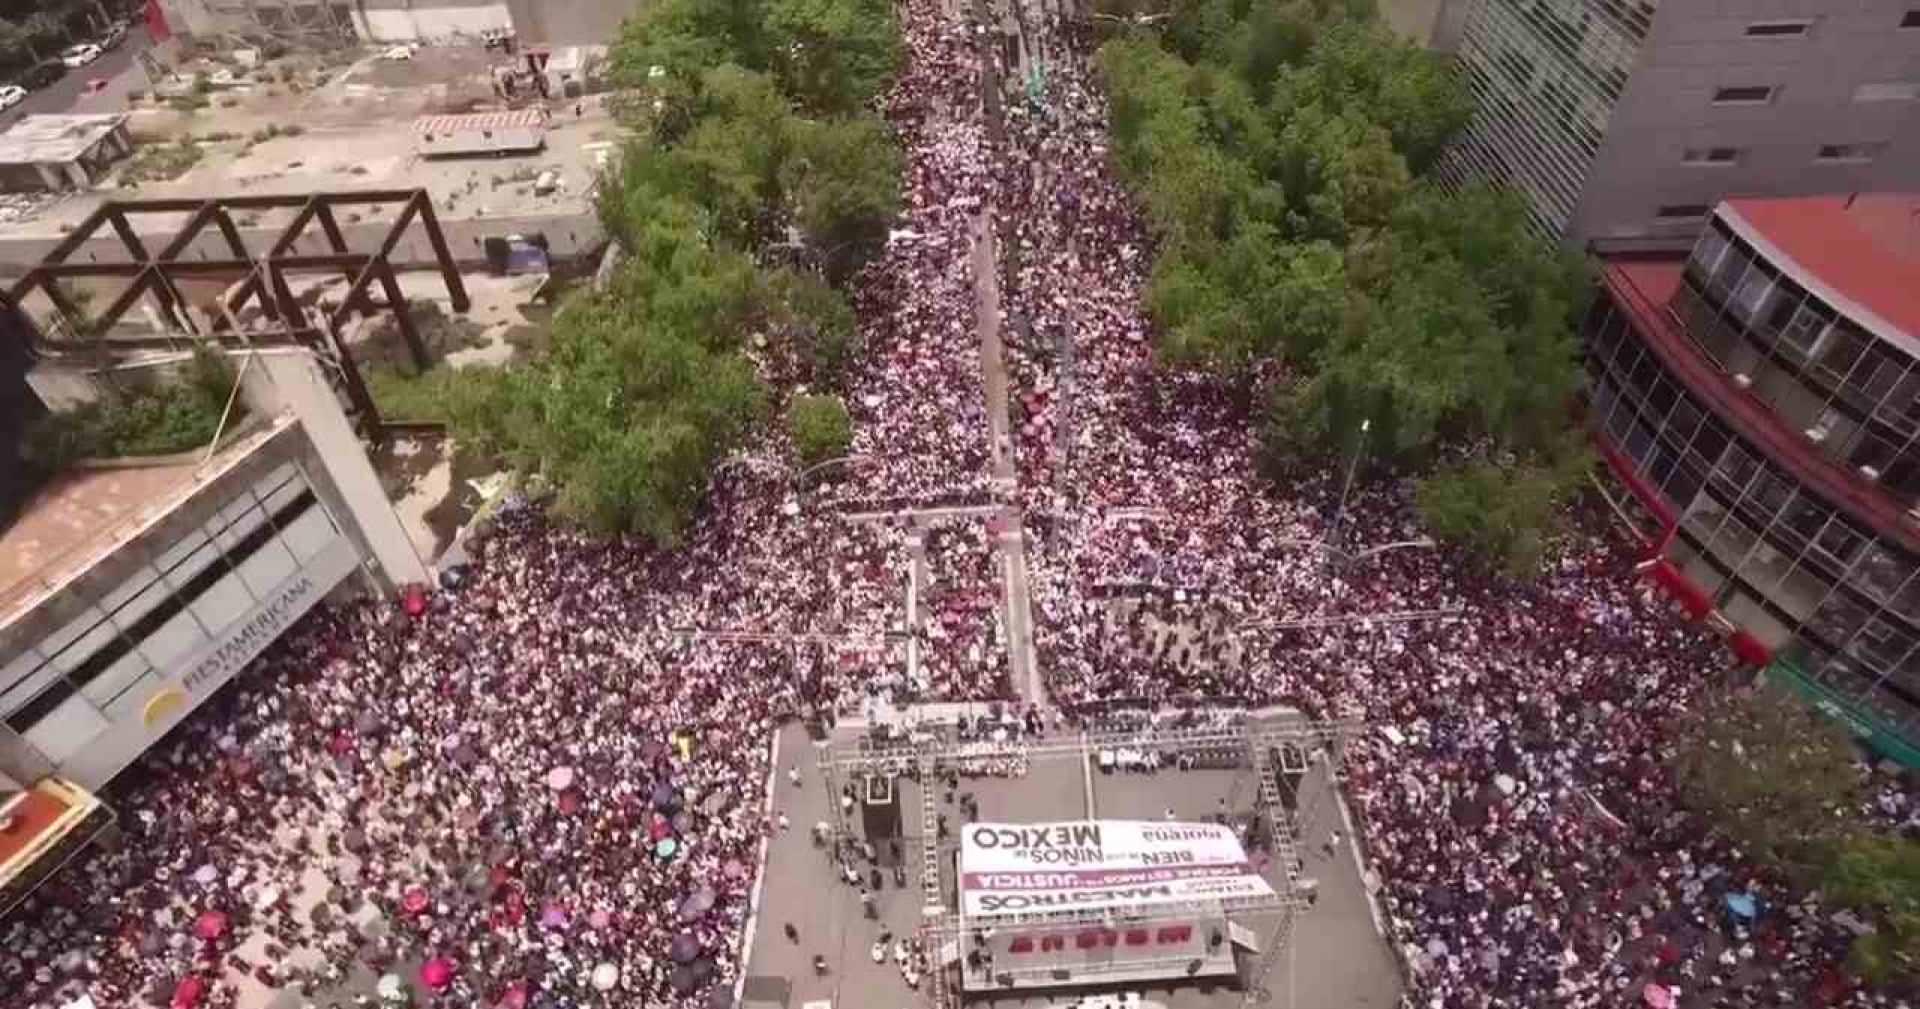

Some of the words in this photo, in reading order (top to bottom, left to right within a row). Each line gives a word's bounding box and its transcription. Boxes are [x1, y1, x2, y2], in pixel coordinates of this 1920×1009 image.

[1030, 848, 1104, 868] NIÑOS
[1140, 850, 1194, 866] BIEN
[977, 874, 1079, 889] JUSTICIA
[979, 887, 1171, 910] MAESTROS
